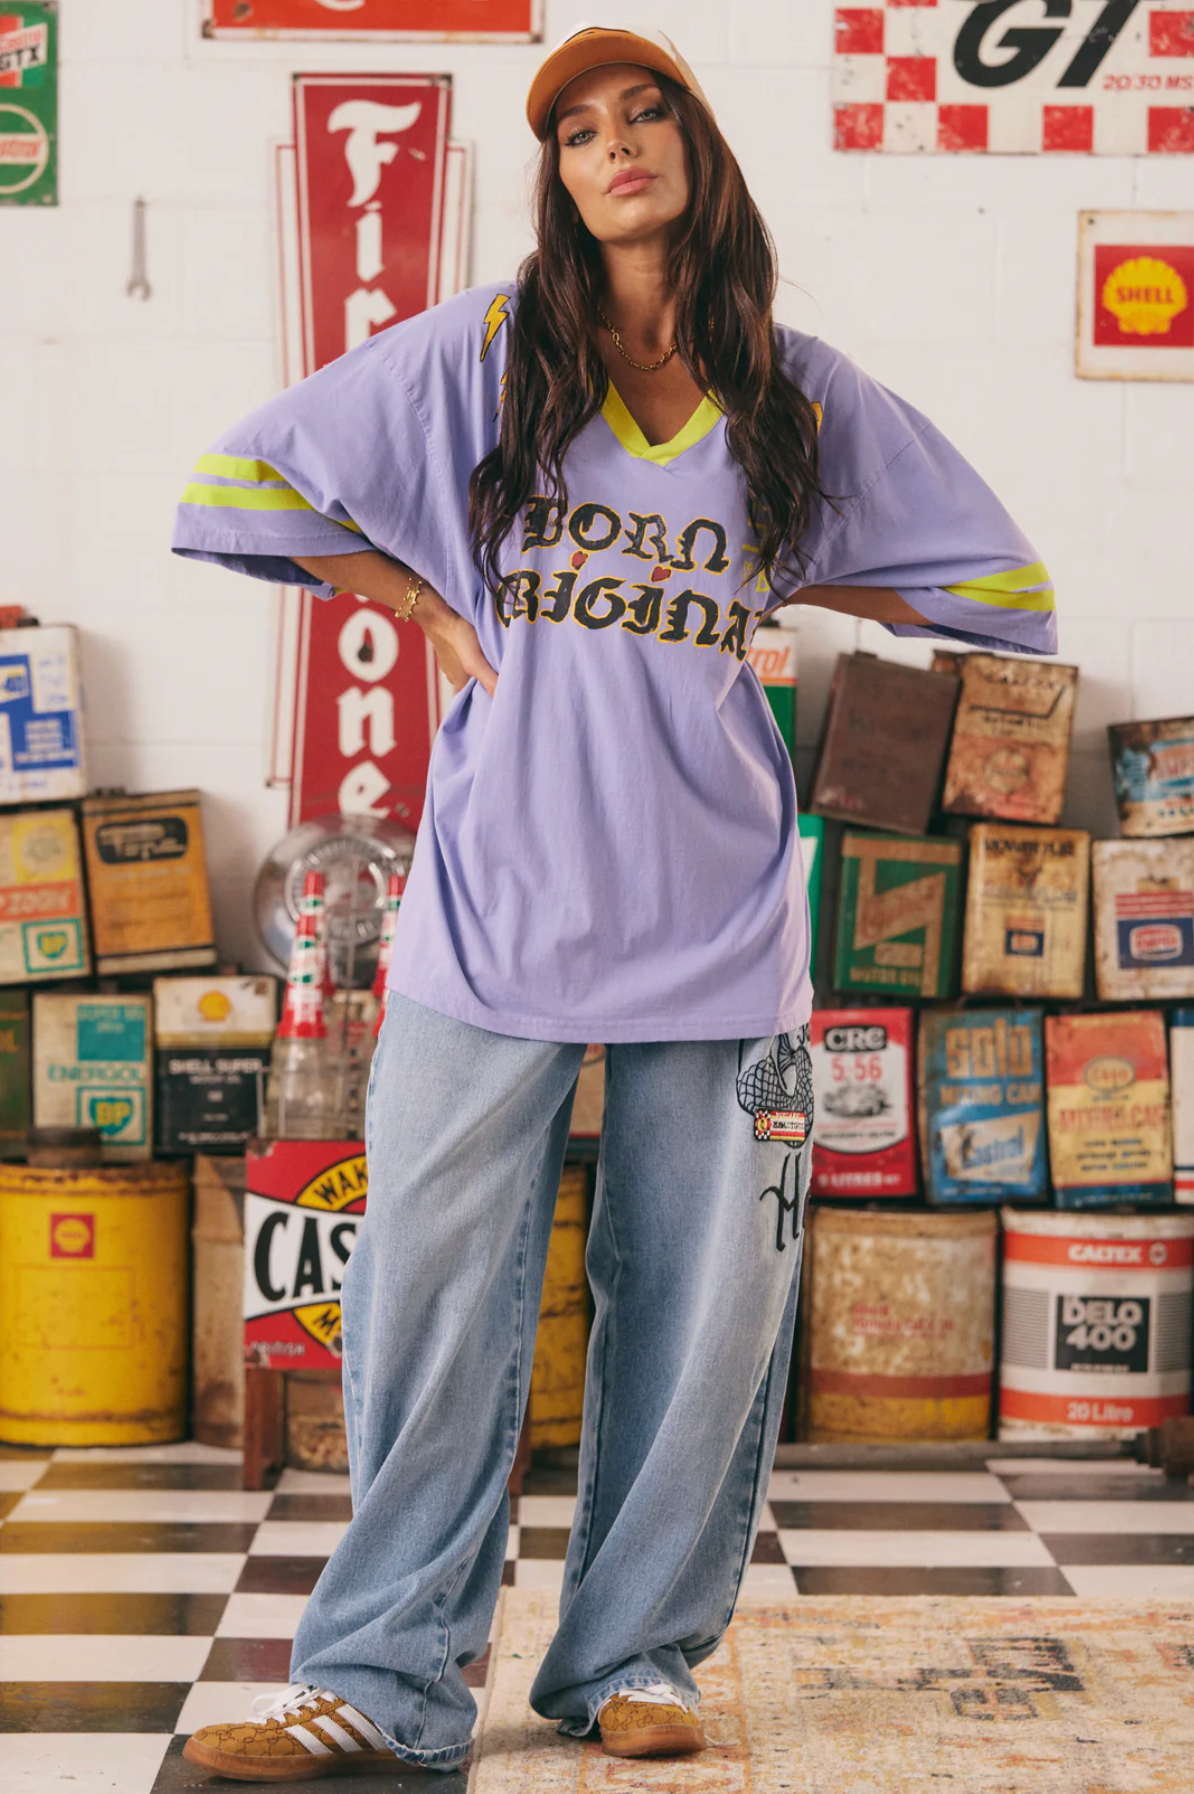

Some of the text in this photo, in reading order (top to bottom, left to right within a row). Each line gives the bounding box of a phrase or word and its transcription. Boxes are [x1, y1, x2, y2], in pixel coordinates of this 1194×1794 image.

[1115, 286, 1174, 304] SHELL
[521, 495, 729, 575] BORN
[826, 1027, 886, 1051] CRC
[946, 1017, 1032, 1078] solo
[48, 1064, 144, 1082] ENERGOL
[169, 1058, 262, 1075] SHELL SUPER
[96, 1102, 131, 1126] BP
[1068, 1244, 1143, 1264] CALTEX
[1062, 1295, 1143, 1327] DELO
[1066, 1324, 1136, 1351] 400
[1067, 1402, 1134, 1422] 20 Litre
